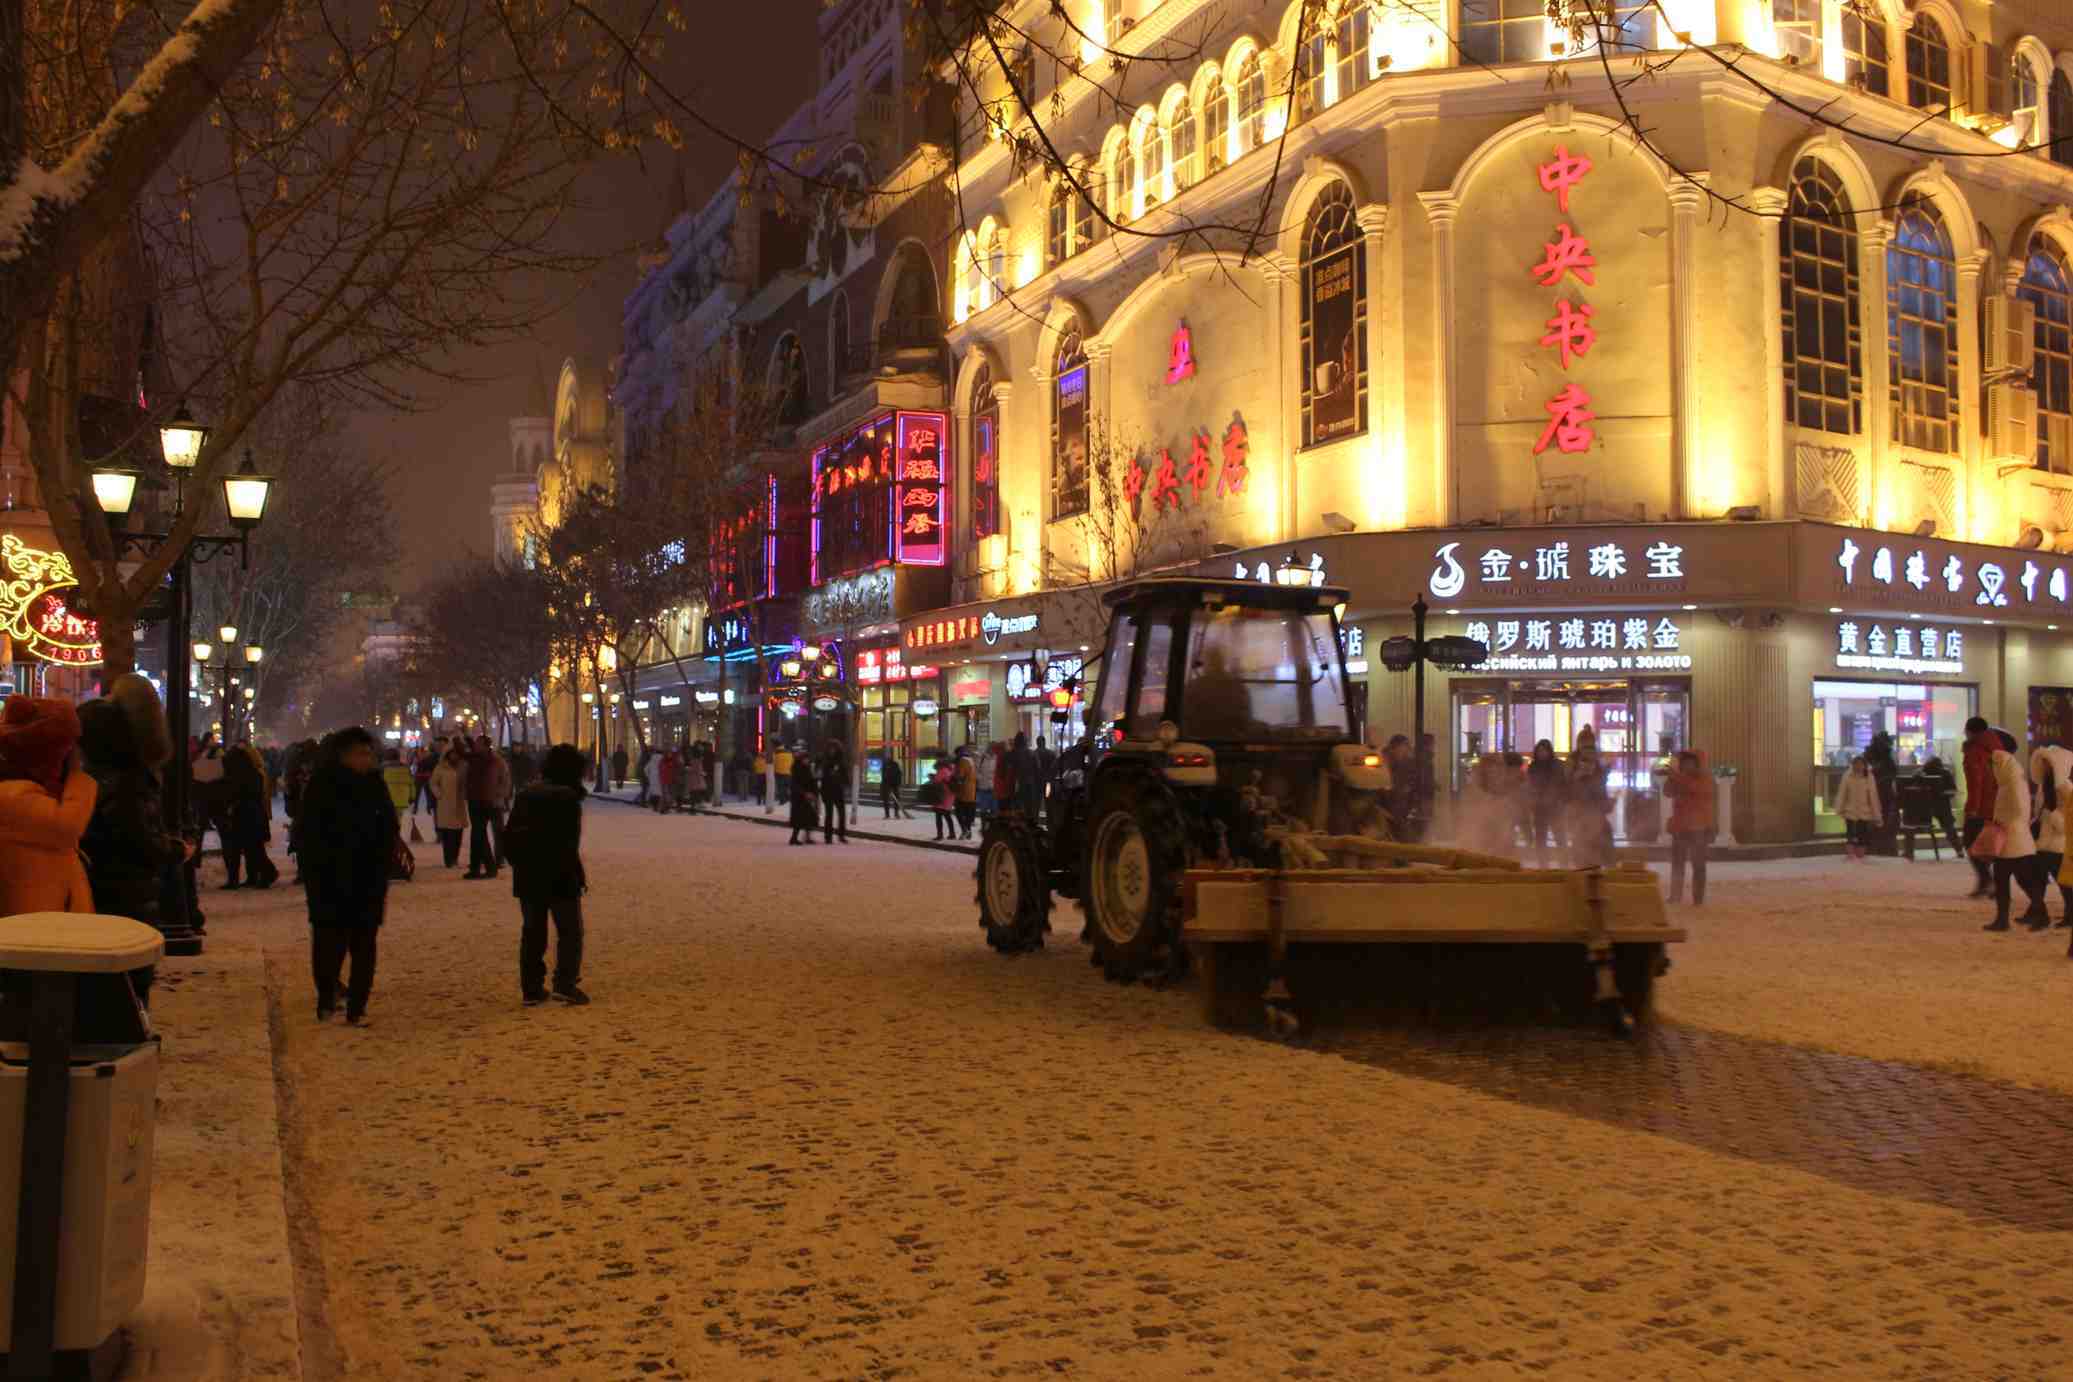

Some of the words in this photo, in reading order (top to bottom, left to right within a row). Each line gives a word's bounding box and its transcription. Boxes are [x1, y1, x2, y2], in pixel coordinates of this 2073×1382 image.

[1533, 144, 1596, 456] 中央书店
[1122, 423, 1248, 520] 中央书店
[1838, 538, 1963, 592] 中国珠宝
[1465, 617, 1681, 651] 俄罗斯琥珀紫金
[1839, 621, 1963, 658] 黄金直营店
[50, 645, 102, 661] 1906
[1462, 654, 1558, 669] ссийский
[1561, 656, 1618, 672] янтарь
[1621, 656, 1632, 668] и
